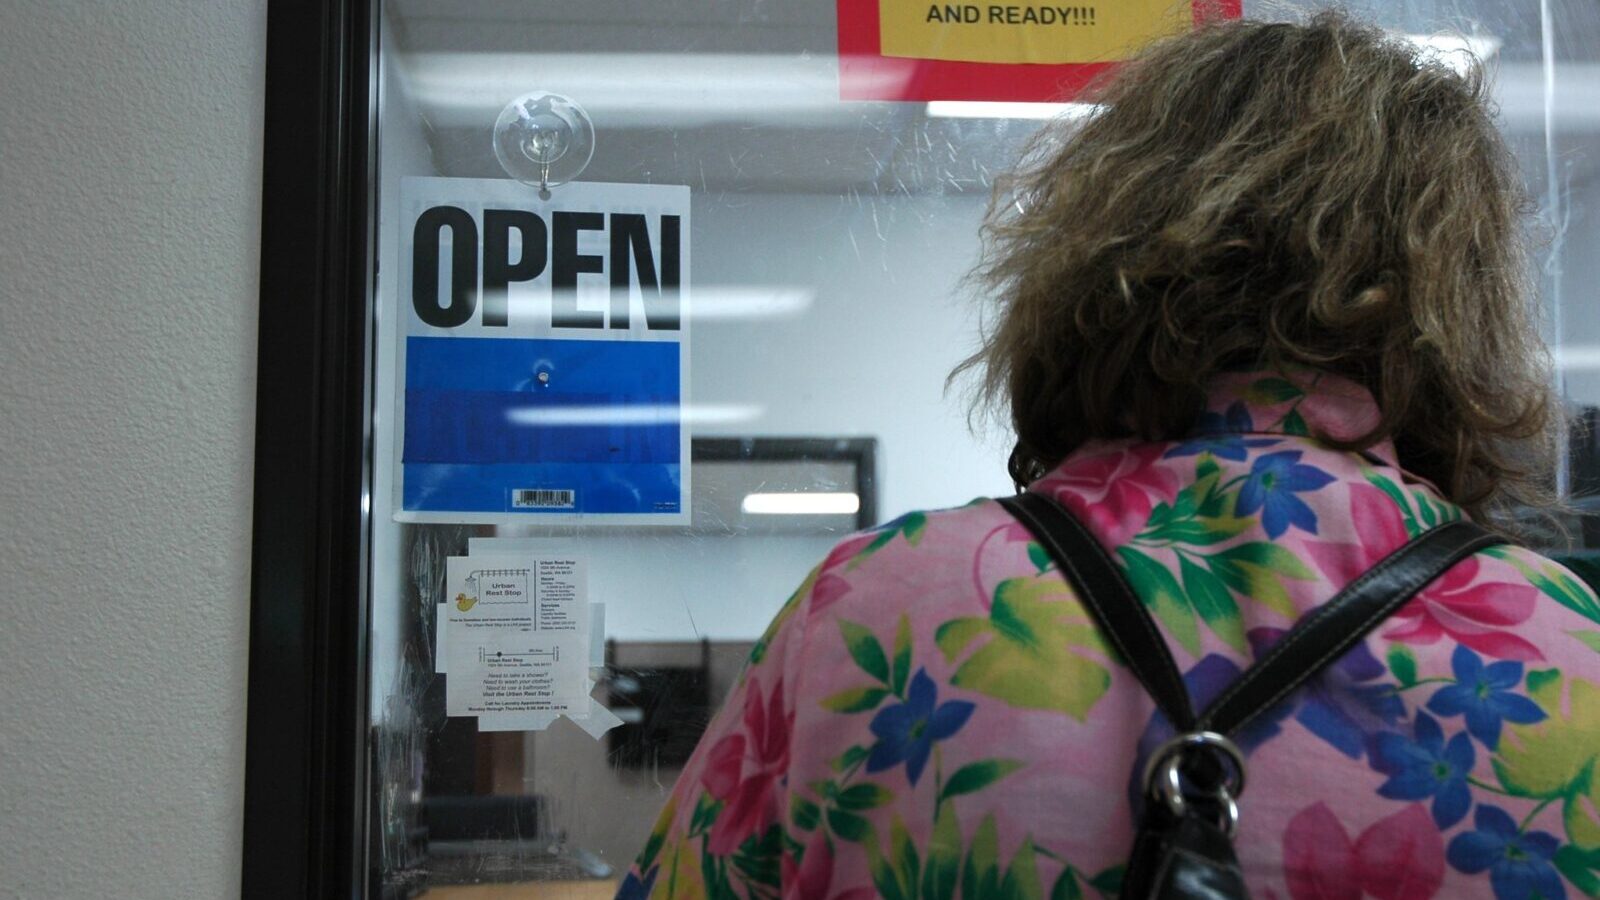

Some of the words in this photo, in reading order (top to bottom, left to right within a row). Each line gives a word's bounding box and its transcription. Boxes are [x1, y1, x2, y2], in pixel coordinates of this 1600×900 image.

[926, 4, 980, 24] AND
[988, 5, 1096, 26] READY!!!
[412, 205, 681, 331] OPEN
[485, 590, 503, 598] Rest
[504, 590, 522, 598] Stop
